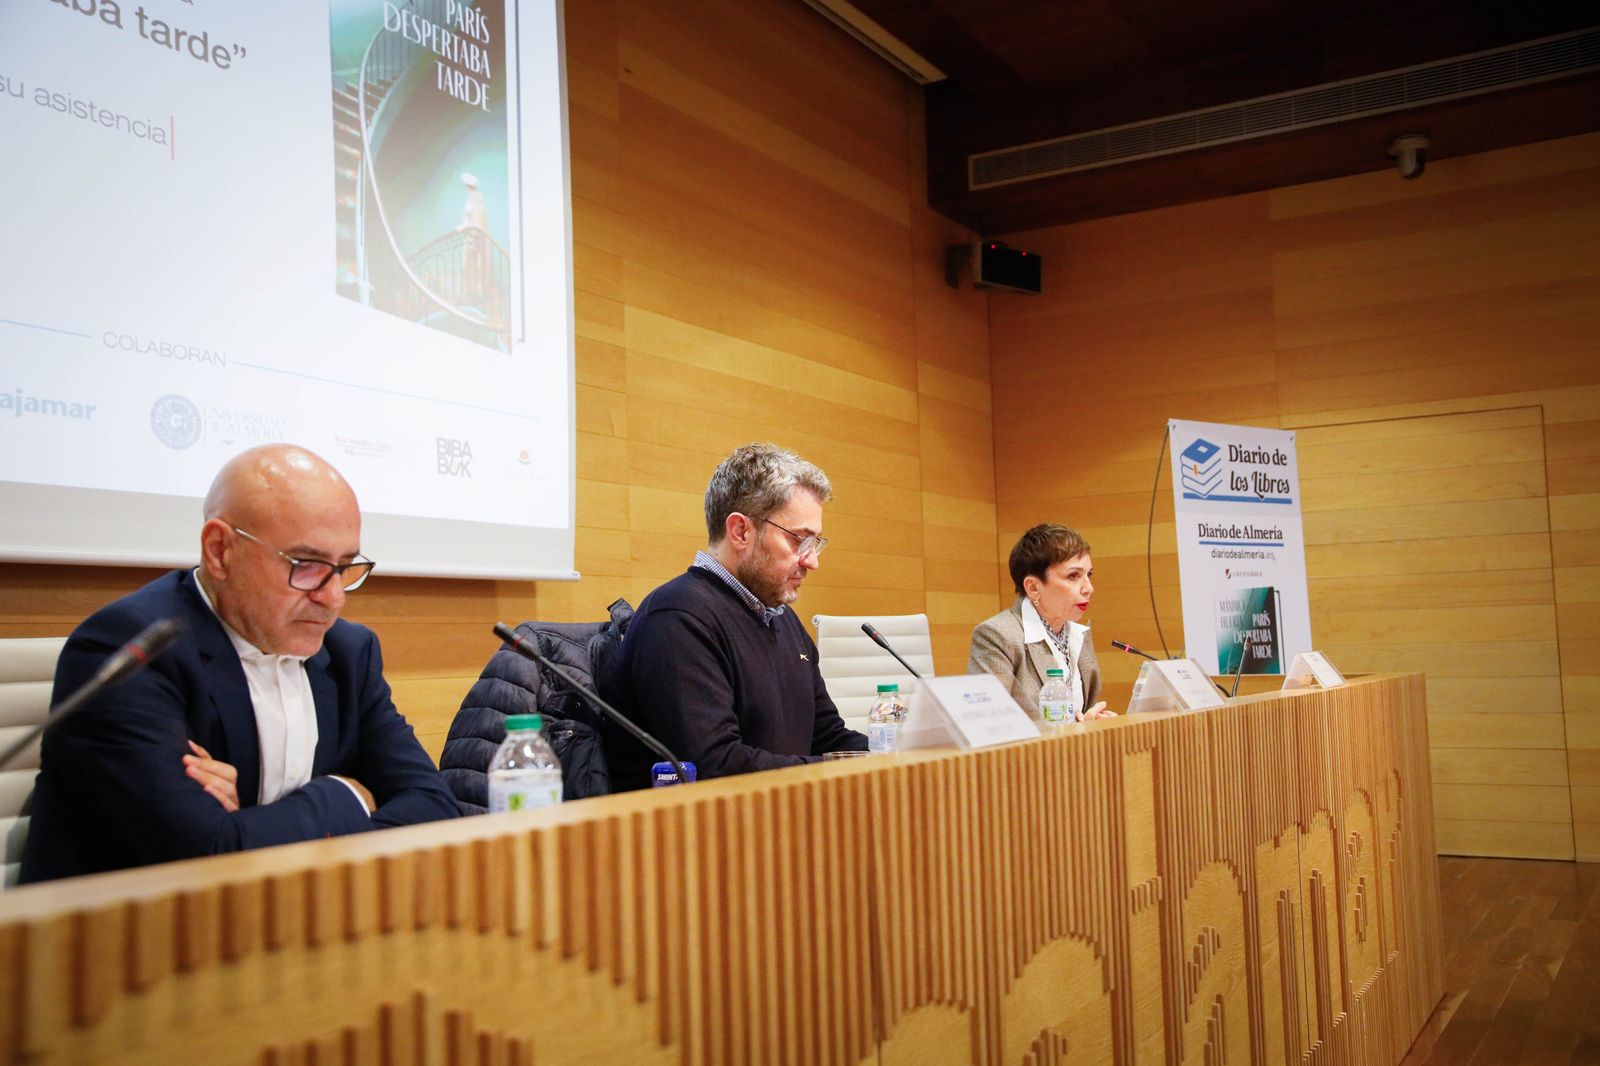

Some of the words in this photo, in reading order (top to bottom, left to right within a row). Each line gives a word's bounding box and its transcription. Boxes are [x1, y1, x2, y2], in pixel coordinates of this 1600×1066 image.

[383, 1, 491, 79] DESPERTABA
[446, 0, 490, 44] PARÍS
[434, 60, 491, 112] TARDE
[34, 87, 168, 146] asistencia
[102, 331, 226, 367] COLABORAN
[436, 437, 473, 460] BIBA
[1228, 444, 1270, 465] Diario
[1272, 448, 1288, 466] de
[1230, 470, 1249, 492] los
[1251, 471, 1290, 499] Libros
[1198, 523, 1228, 538] Diario
[1228, 524, 1242, 539] de
[1243, 525, 1283, 540] Almería
